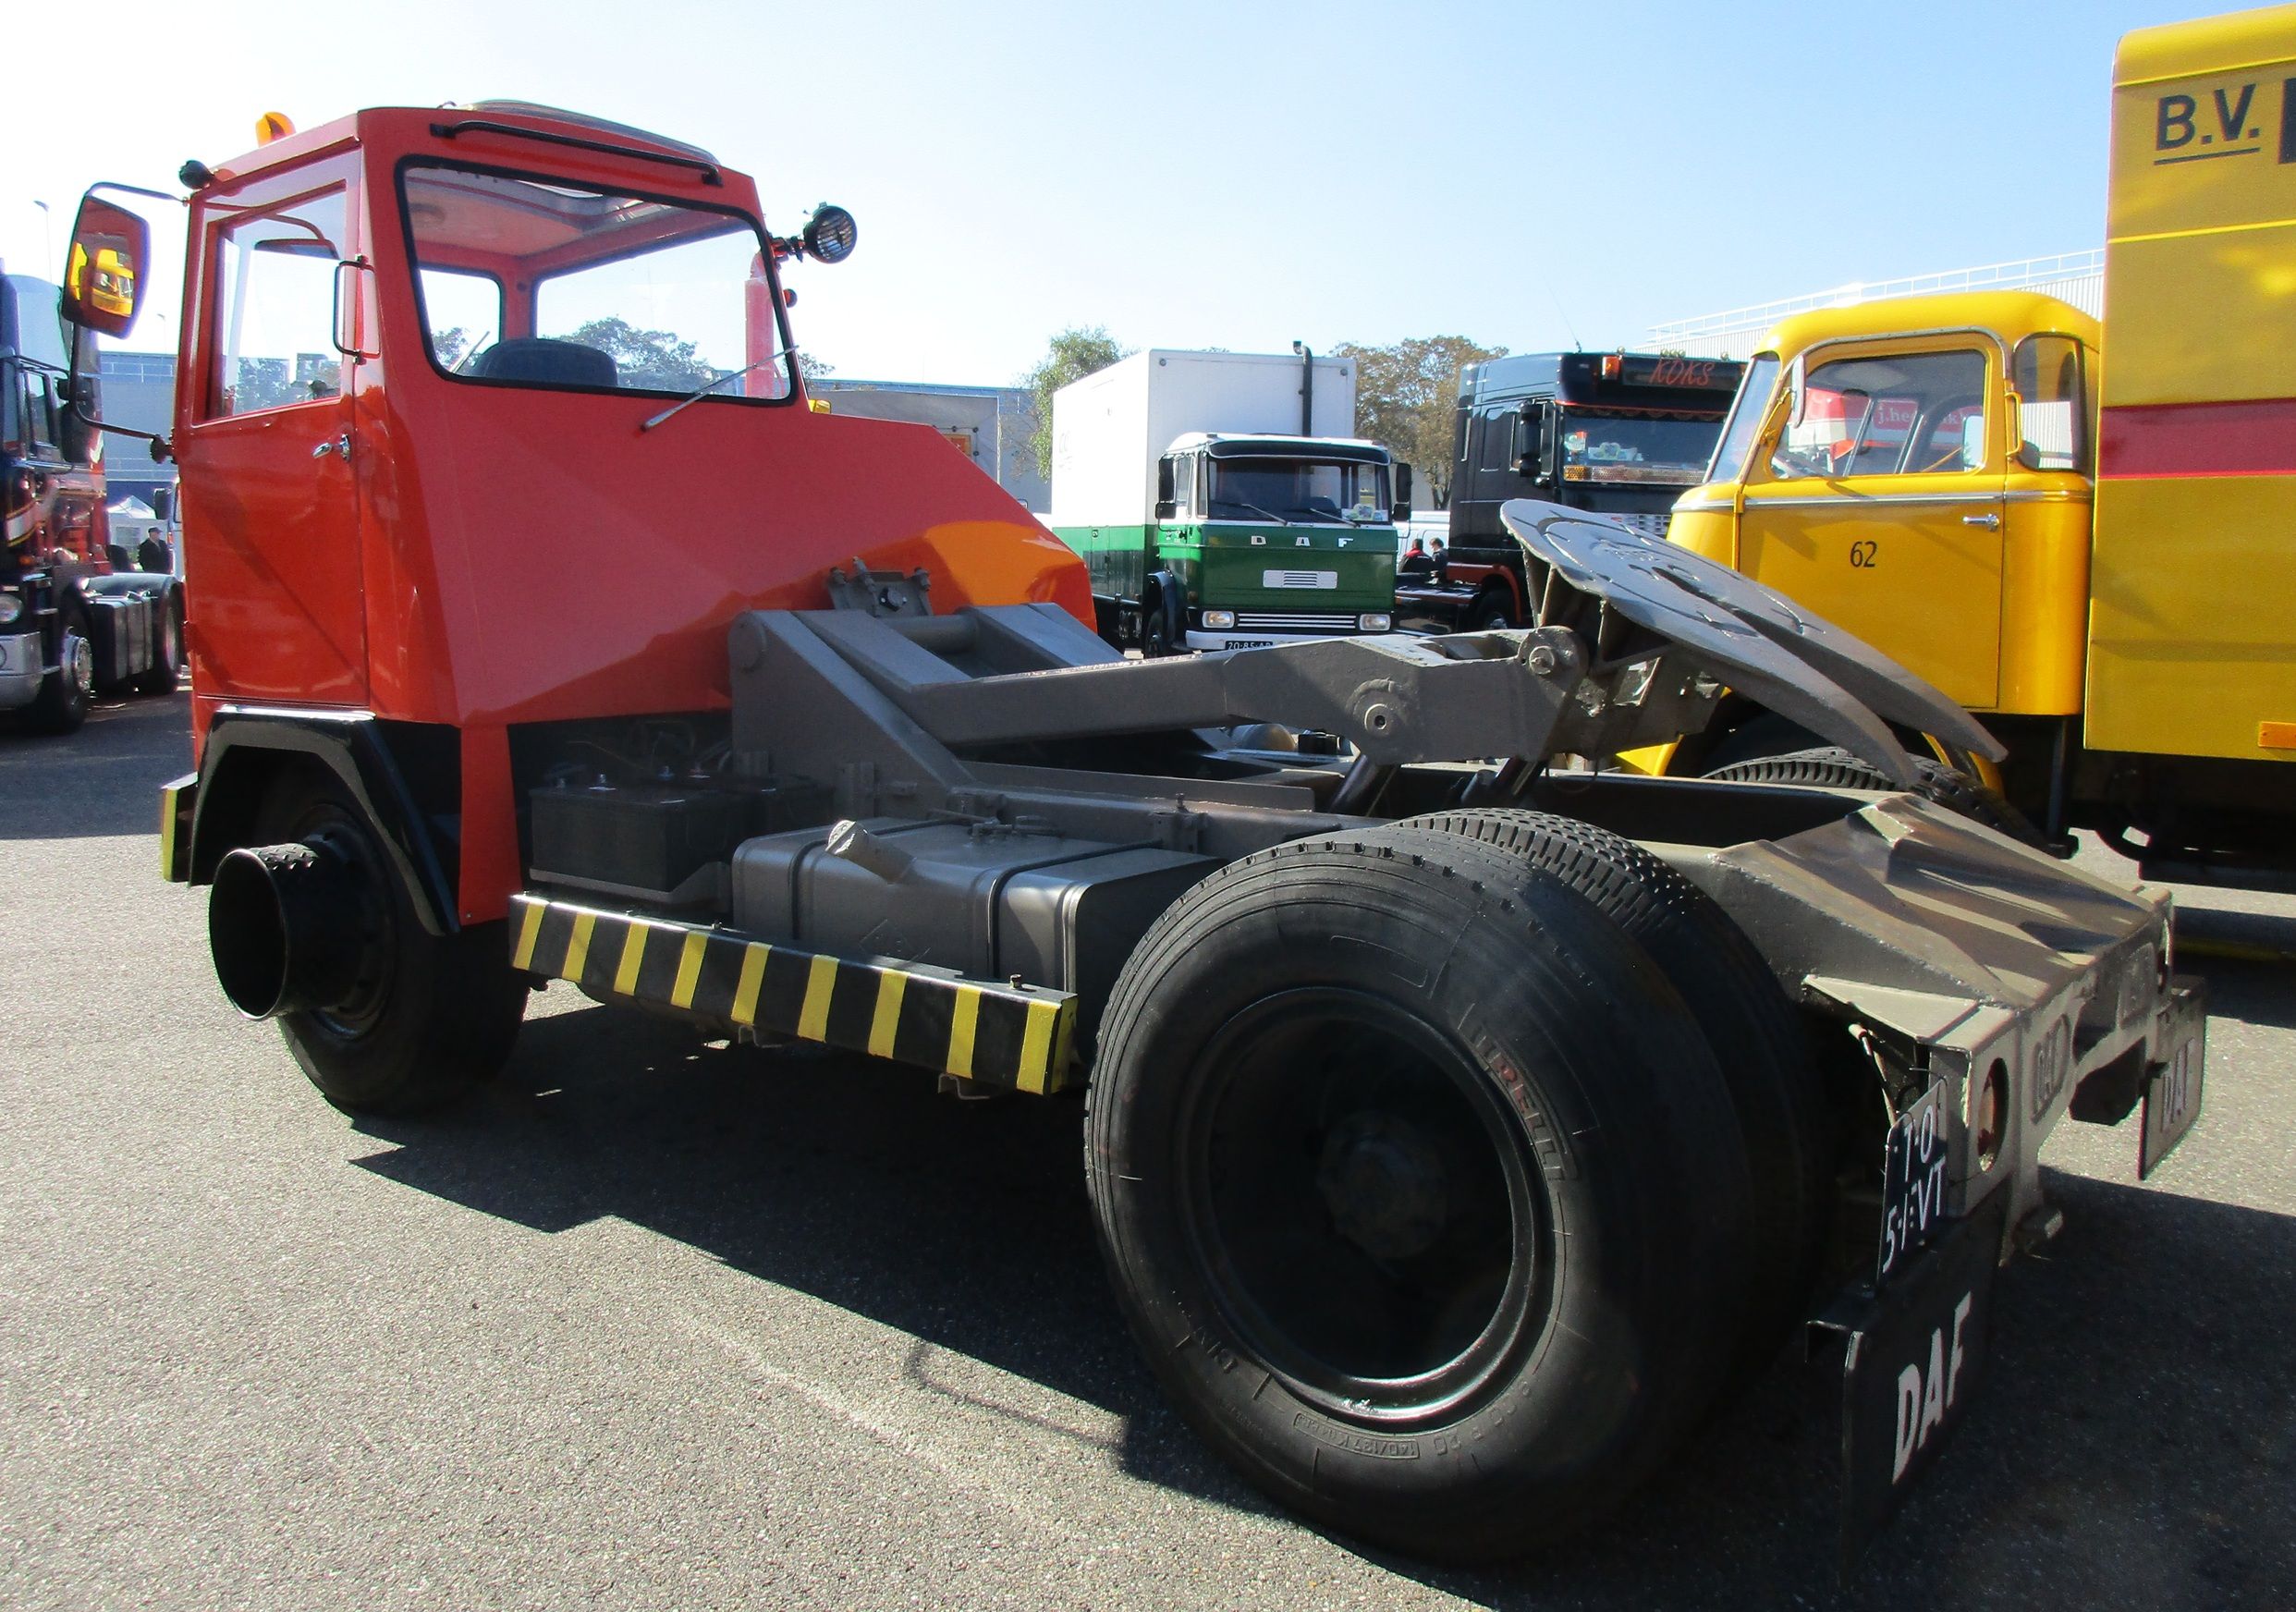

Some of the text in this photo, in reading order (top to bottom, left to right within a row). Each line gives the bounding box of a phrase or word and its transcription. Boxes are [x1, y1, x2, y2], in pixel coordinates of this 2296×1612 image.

[2156, 83, 2260, 151] B.V.
[1648, 359, 1716, 386] KOKS
[1251, 535, 1354, 548] DAF
[1850, 541, 1877, 568] 62
[1892, 1290, 1972, 1484] DAF
